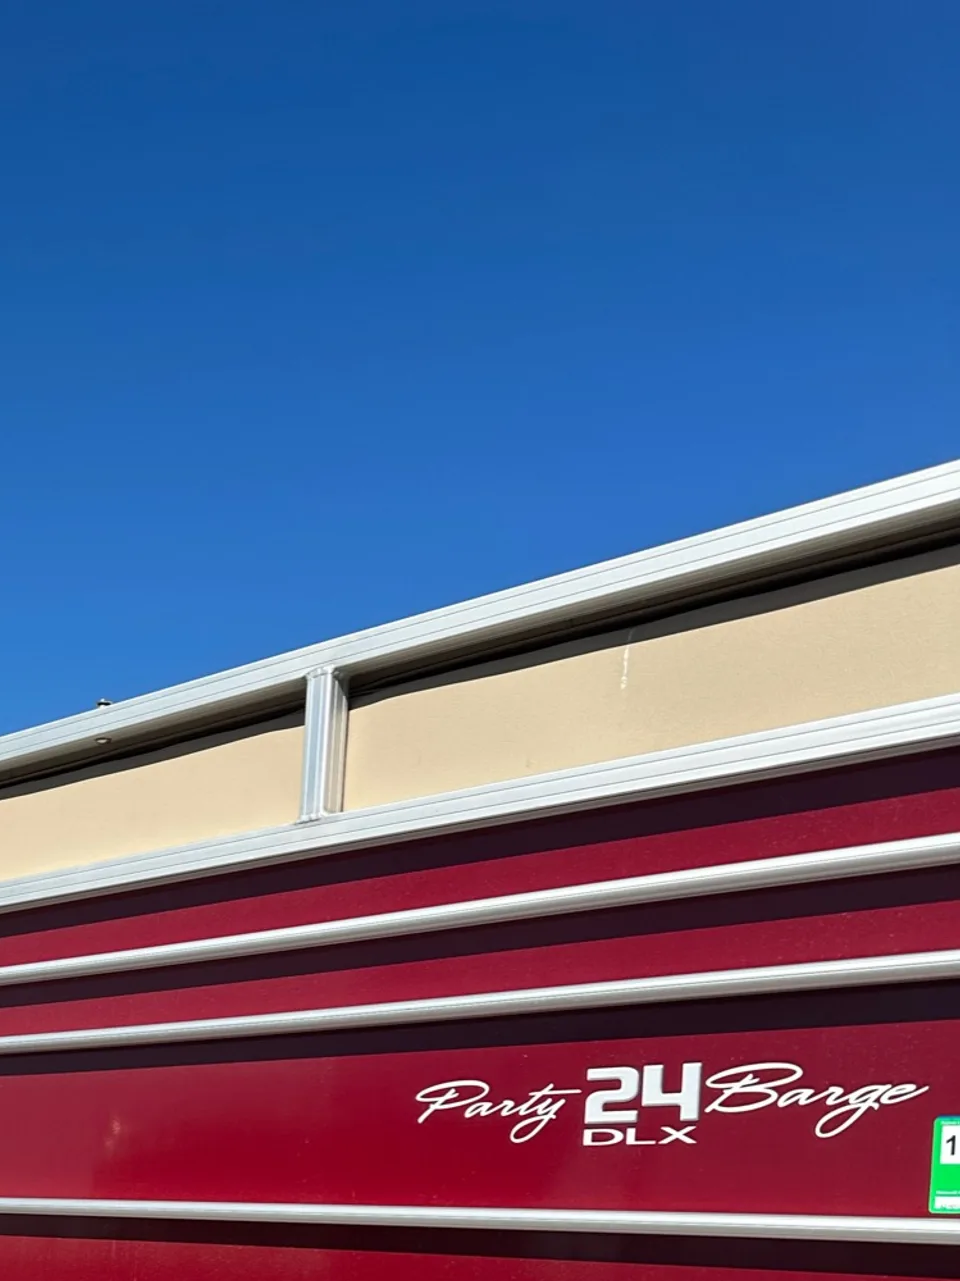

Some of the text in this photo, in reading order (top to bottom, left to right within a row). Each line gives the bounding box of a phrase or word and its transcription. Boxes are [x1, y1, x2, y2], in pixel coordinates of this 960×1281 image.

[415, 1062, 929, 1143] Party 24 Barge
[582, 1125, 698, 1146] DLX
